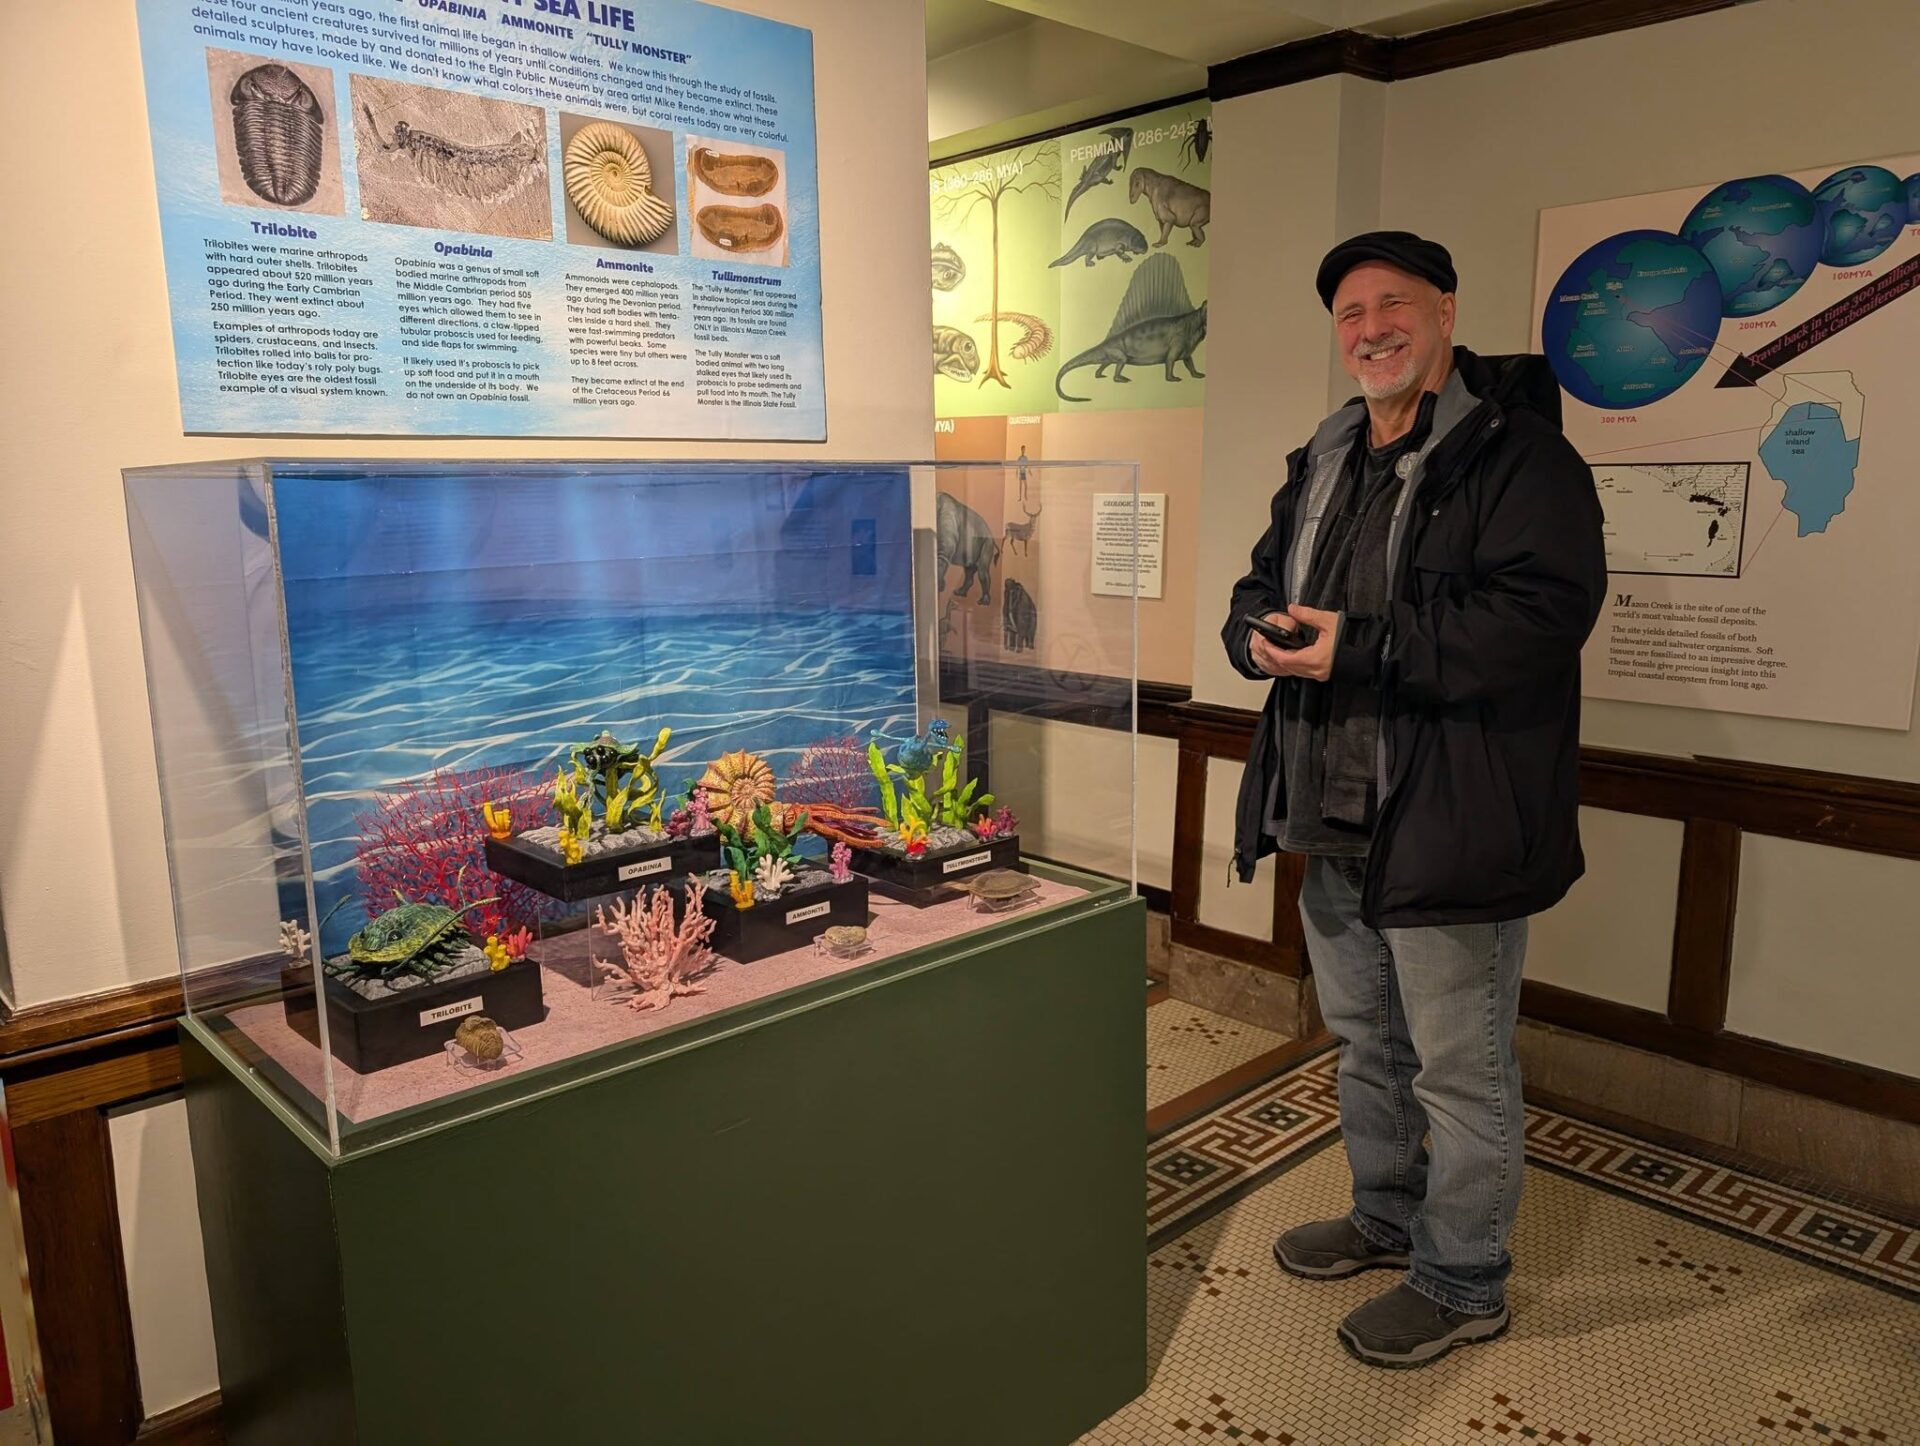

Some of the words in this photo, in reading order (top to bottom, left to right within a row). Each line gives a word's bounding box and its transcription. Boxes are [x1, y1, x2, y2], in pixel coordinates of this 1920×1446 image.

[418, 0, 487, 20] OPABINIA
[501, 14, 574, 40] AMMONITE
[588, 1, 635, 32] LIFE
[231, 0, 256, 11] four
[260, 5, 308, 22] ancient
[312, 15, 368, 34] creatures
[371, 27, 419, 44] survived
[421, 34, 438, 49] for
[439, 40, 479, 57] millions
[482, 48, 491, 58] of
[493, 48, 523, 65] years
[524, 57, 547, 70] until
[548, 59, 599, 82] conditions
[600, 73, 643, 88] changed
[645, 83, 662, 92] and
[665, 85, 684, 99] they
[686, 89, 722, 104] became
[724, 99, 753, 111] extinct.
[755, 103, 777, 115] These
[311, 0, 345, 14] years
[348, 8, 375, 21] ago,
[378, 11, 397, 24] the
[400, 15, 419, 29] first
[422, 23, 460, 38] animal
[462, 28, 478, 41] life
[481, 33, 515, 49] began
[518, 41, 527, 52] in
[529, 44, 567, 62] shallow
[568, 53, 603, 67] waters.
[608, 60, 623, 71] We
[625, 63, 650, 76] know
[652, 69, 667, 80] this
[668, 73, 702, 88] through
[704, 80, 717, 91] the
[720, 85, 741, 97] study
[743, 89, 750, 98] of
[752, 90, 778, 104] fossils.
[191, 6, 247, 26] detailed
[251, 19, 317, 40] sculptures,
[321, 33, 357, 46] made
[361, 37, 375, 52] by
[379, 44, 402, 55] and
[405, 47, 452, 65] donated
[454, 56, 466, 69] to
[468, 59, 485, 71] the
[488, 63, 515, 78] Elgin
[515, 68, 545, 83] Public
[549, 75, 589, 92] Museum
[592, 83, 605, 99] by
[606, 85, 628, 99] area
[630, 93, 651, 103] artist
[654, 96, 675, 108] Mike
[678, 100, 707, 115] Rende,
[709, 108, 730, 118] show
[733, 112, 752, 125] what
[754, 116, 775, 127] these
[193, 24, 245, 41] animals
[249, 34, 277, 49] may
[281, 38, 313, 54] have
[316, 45, 359, 62] looked
[362, 53, 385, 67] like.
[389, 59, 407, 71] We
[410, 63, 438, 77] don't
[441, 68, 471, 83] know
[473, 76, 500, 89] what
[502, 82, 534, 95] colors
[535, 86, 562, 100] these
[564, 94, 602, 108] animals
[603, 96, 629, 114] were,
[632, 105, 646, 116] but
[649, 110, 672, 120] coral
[674, 115, 694, 125] reefs
[696, 117, 720, 131] today
[723, 124, 737, 132] are
[739, 127, 756, 138] very
[758, 130, 789, 143] colorful.
[1070, 138, 1124, 163] PERMIAN
[997, 160, 1023, 180] MYA)
[252, 221, 317, 240] Trilobite
[203, 238, 248, 250] Trilobites
[251, 244, 276, 253] were
[279, 247, 314, 256] marine
[316, 250, 367, 262] arthropods
[434, 242, 493, 258] Opabinia
[205, 251, 226, 261] with
[229, 253, 253, 263] hard
[256, 256, 282, 266] outer
[285, 259, 314, 268] shells.
[316, 261, 357, 272] Trilobites
[394, 256, 435, 268] Opabinia
[438, 262, 455, 270] was
[465, 265, 490, 273] genus
[492, 266, 500, 274] of
[596, 258, 654, 273] Ammonite
[564, 273, 609, 283] Ammonoids
[631, 280, 679, 289] cephalopods.
[712, 270, 782, 287] Tullimonstrum
[1832, 269, 1873, 281] 100MYA
[691, 283, 703, 291] The
[704, 284, 722, 294] “Tully
[724, 286, 752, 295] Monster”
[765, 291, 796, 299] appeared
[1750, 341, 1782, 366] Travel
[1784, 322, 1809, 344] back
[1811, 314, 1822, 331] in
[1824, 300, 1850, 323] time
[1850, 286, 1875, 308] 300
[1876, 260, 1919, 292] million
[1797, 340, 1808, 352] to
[1810, 327, 1828, 345] the
[1829, 279, 1910, 332] Carboniferous
[1738, 320, 1777, 330] 200MYA
[1784, 428, 1816, 436] shallow
[1785, 437, 1811, 446] inland
[1613, 594, 1649, 608] Mazon
[1650, 601, 1673, 609] Creek
[1674, 602, 1681, 610] is
[1683, 602, 1696, 611] the
[1698, 603, 1713, 611] site
[1714, 604, 1724, 612] of
[1741, 606, 1751, 614] of
[1752, 606, 1766, 615] the
[1612, 610, 1640, 619] world's
[1662, 613, 1695, 622] valuable
[1697, 614, 1718, 623] fossil
[1720, 616, 1757, 626] deposits.
[628, 862, 662, 876] OPABINIA
[792, 905, 825, 920] AMMONITE
[431, 1002, 473, 1021] TRILOBITE
